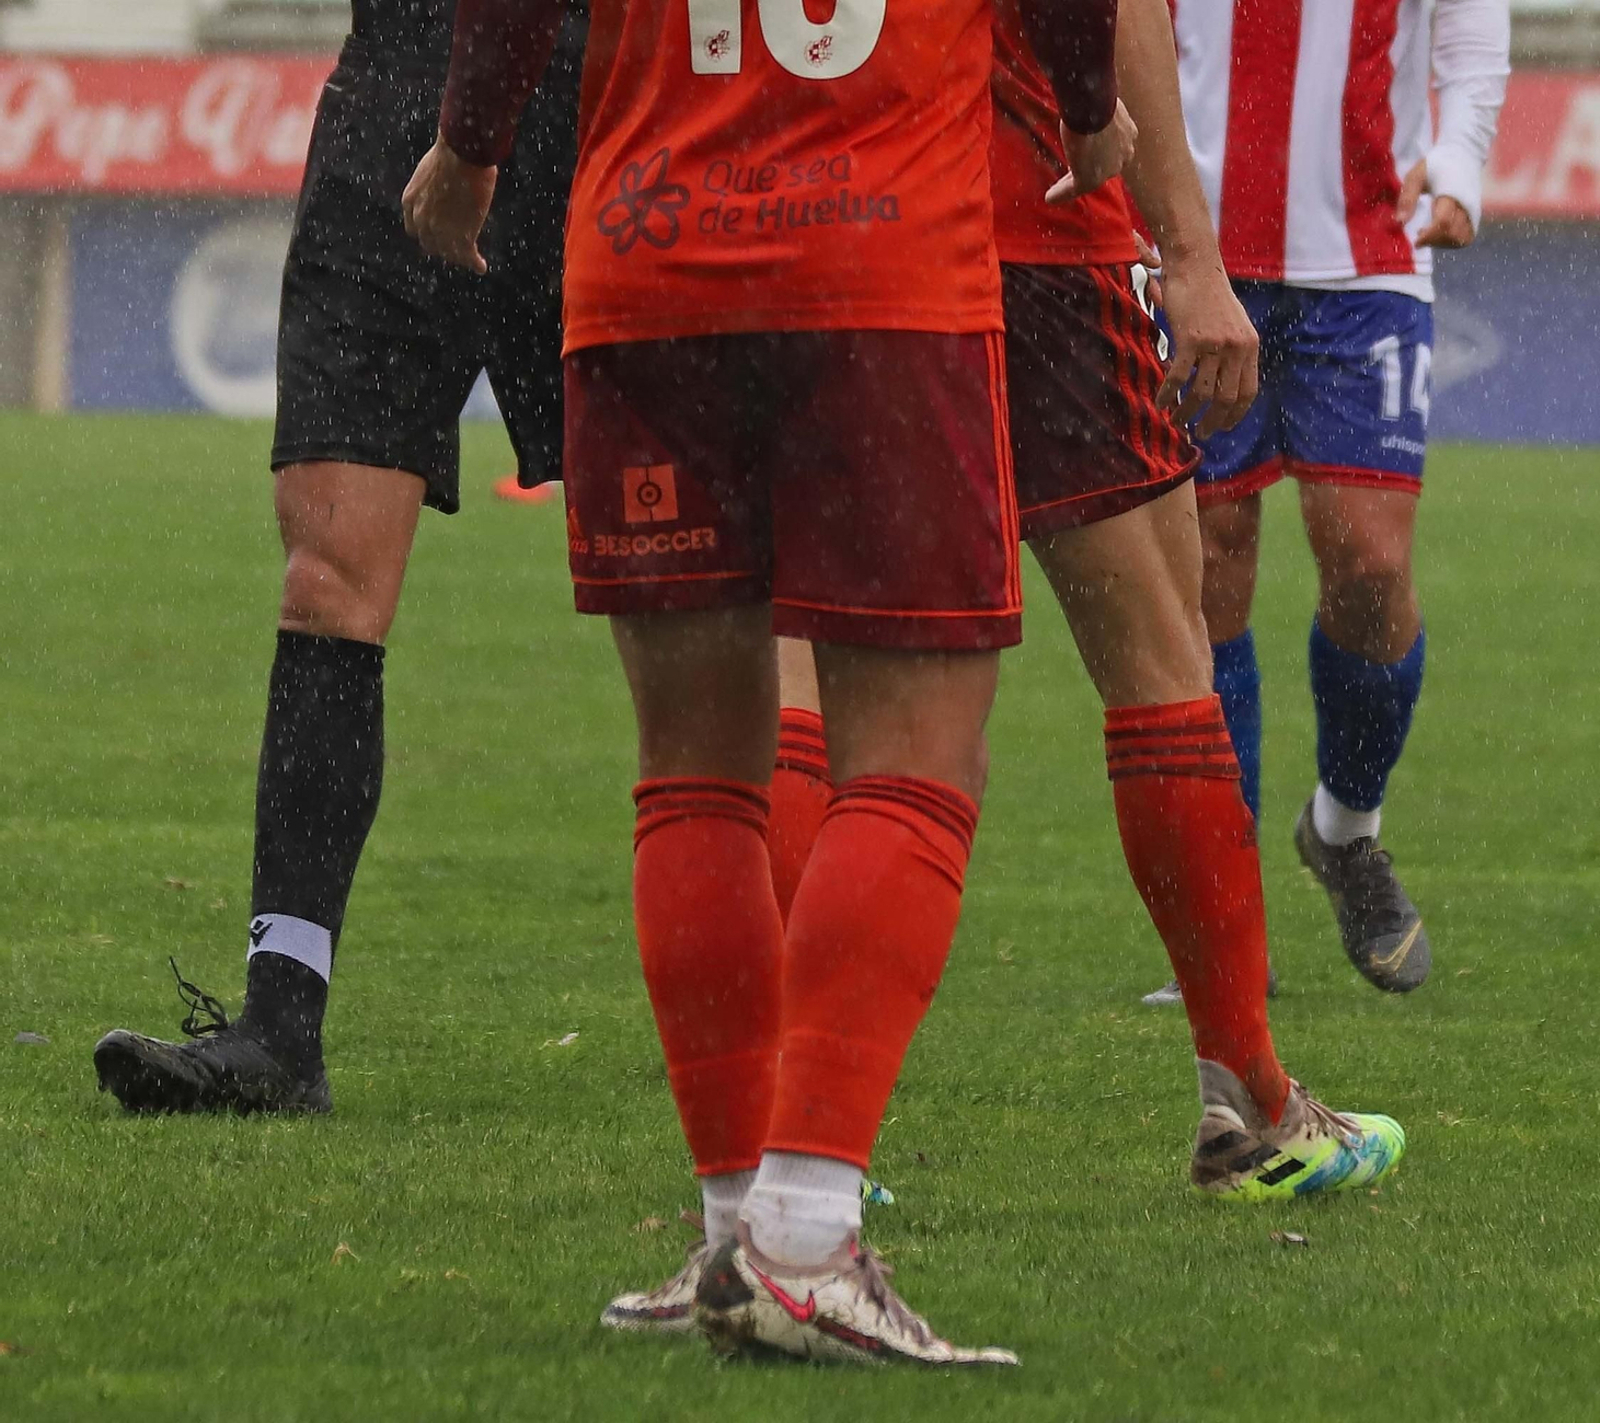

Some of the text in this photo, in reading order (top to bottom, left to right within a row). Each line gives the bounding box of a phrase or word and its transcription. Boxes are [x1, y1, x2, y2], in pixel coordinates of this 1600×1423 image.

[703, 154, 851, 197] Que sea
[698, 188, 901, 235] de Huelva
[594, 527, 717, 557] BESOCCER
